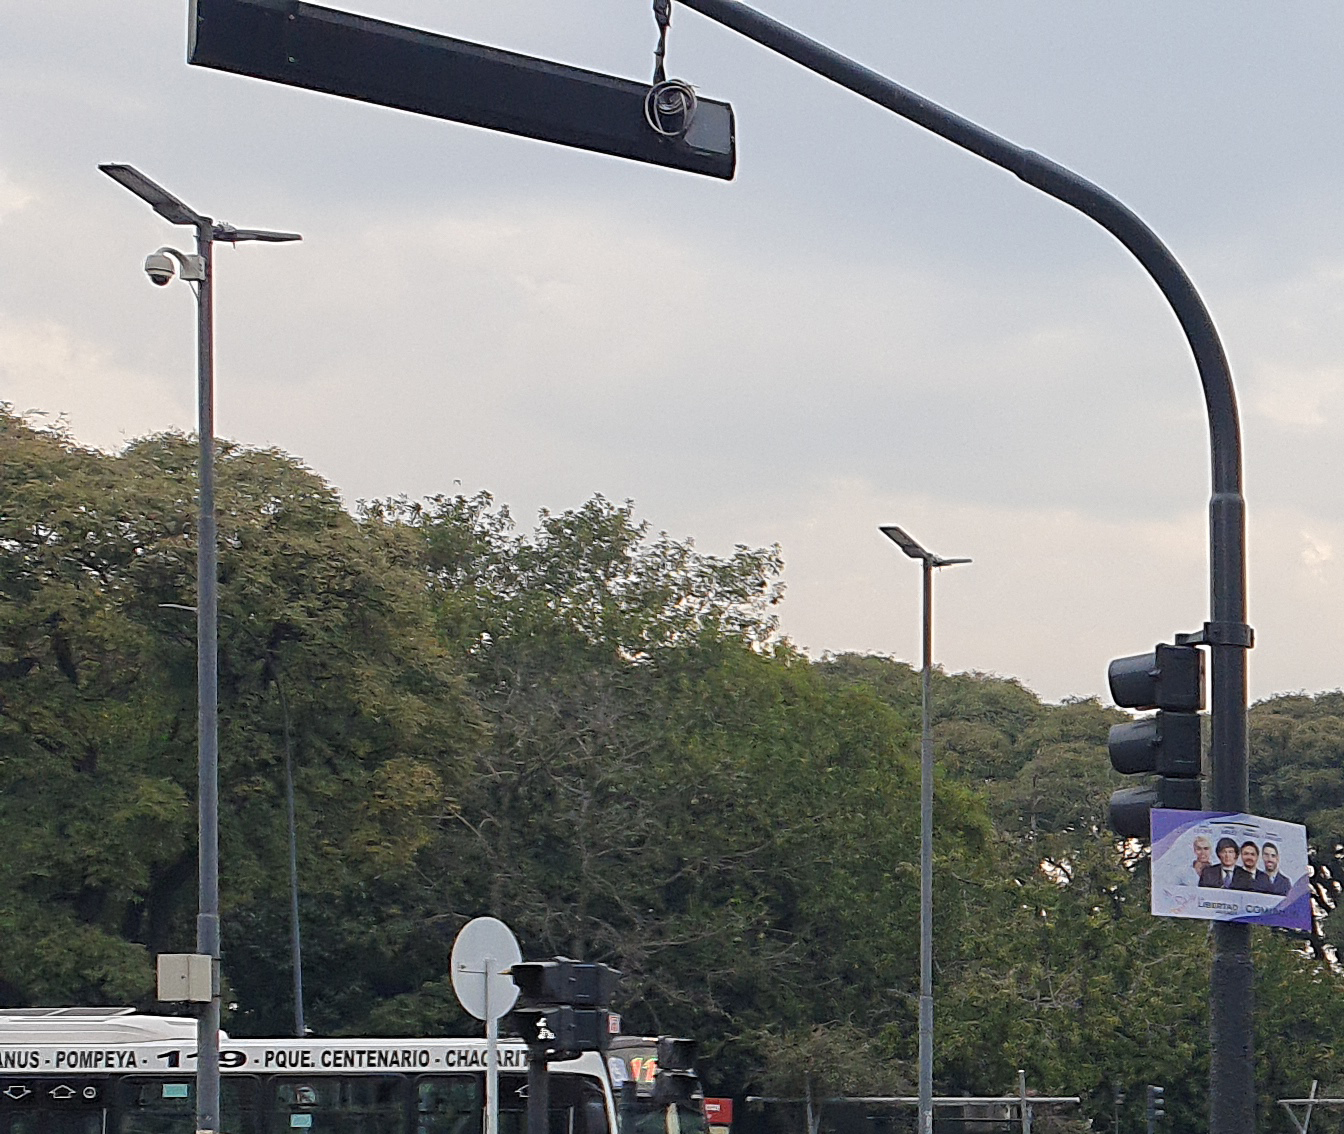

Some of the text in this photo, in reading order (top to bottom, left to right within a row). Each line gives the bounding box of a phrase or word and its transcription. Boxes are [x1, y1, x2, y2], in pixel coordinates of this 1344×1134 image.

[56, 1051, 138, 1068] POMPEYA
[157, 1050, 248, 1068] 19
[264, 1050, 315, 1068] PQUE.
[321, 1050, 429, 1067] CENTENARIO
